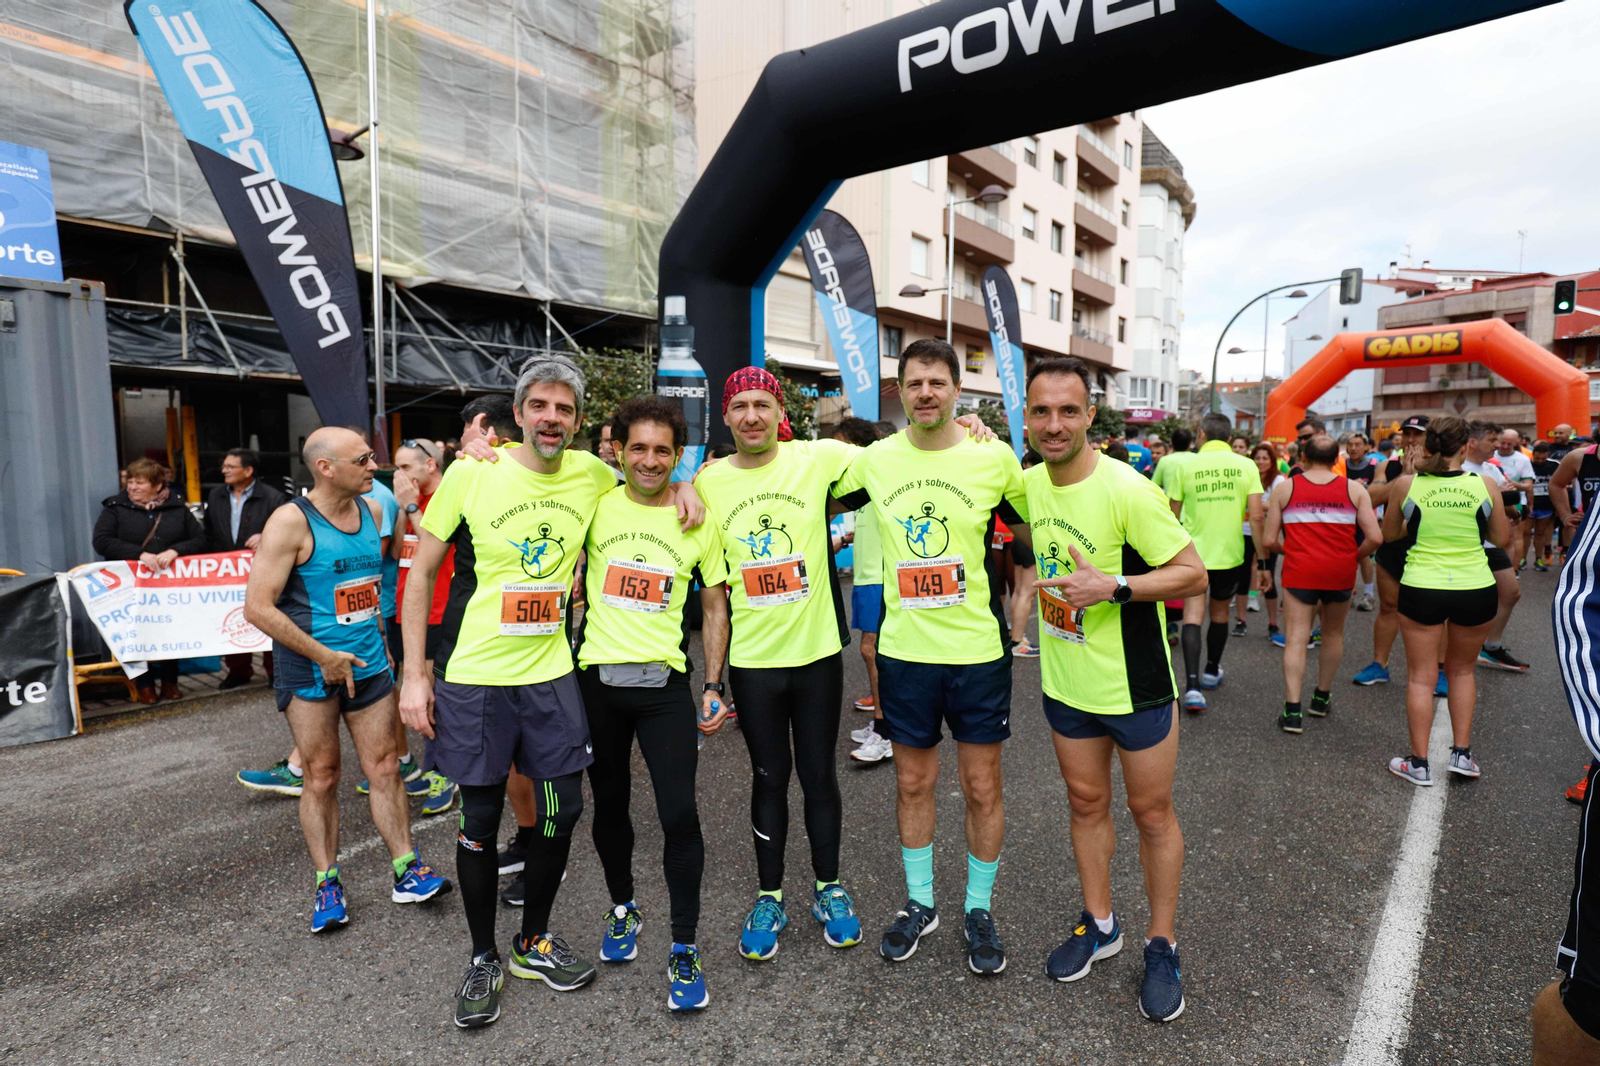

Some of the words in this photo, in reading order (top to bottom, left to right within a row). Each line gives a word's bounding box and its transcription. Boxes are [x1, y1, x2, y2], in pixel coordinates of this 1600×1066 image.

[898, 0, 1176, 93] POWE
[1368, 332, 1460, 357] GADIS
[1195, 469, 1220, 480] mais
[1223, 468, 1242, 479] que
[883, 481, 915, 507] Carreras
[917, 479, 922, 489] y
[925, 478, 975, 509] sobremesas
[1195, 483, 1208, 493] un
[1211, 480, 1234, 493] plan
[1420, 490, 1437, 503] CLUB
[1439, 487, 1480, 503] ATLETISMO
[749, 497, 754, 506] y
[756, 492, 806, 509] sobremesas
[490, 502, 529, 529] Carreras
[531, 501, 537, 510] y
[540, 500, 585, 526] sobremesas
[1047, 517, 1051, 527] y
[1053, 518, 1097, 554] sobremesas
[351, 553, 375, 563] CASTRO
[631, 532, 636, 541] y
[640, 532, 684, 567] sobremesas
[620, 575, 650, 600] 153
[758, 571, 787, 595] 164
[914, 574, 943, 596] 149
[167, 592, 191, 606] SU
[347, 590, 372, 612] 669
[517, 600, 551, 622] 504
[1042, 597, 1065, 629] 738
[161, 641, 203, 652] SUELO
[0, 680, 48, 707] te
